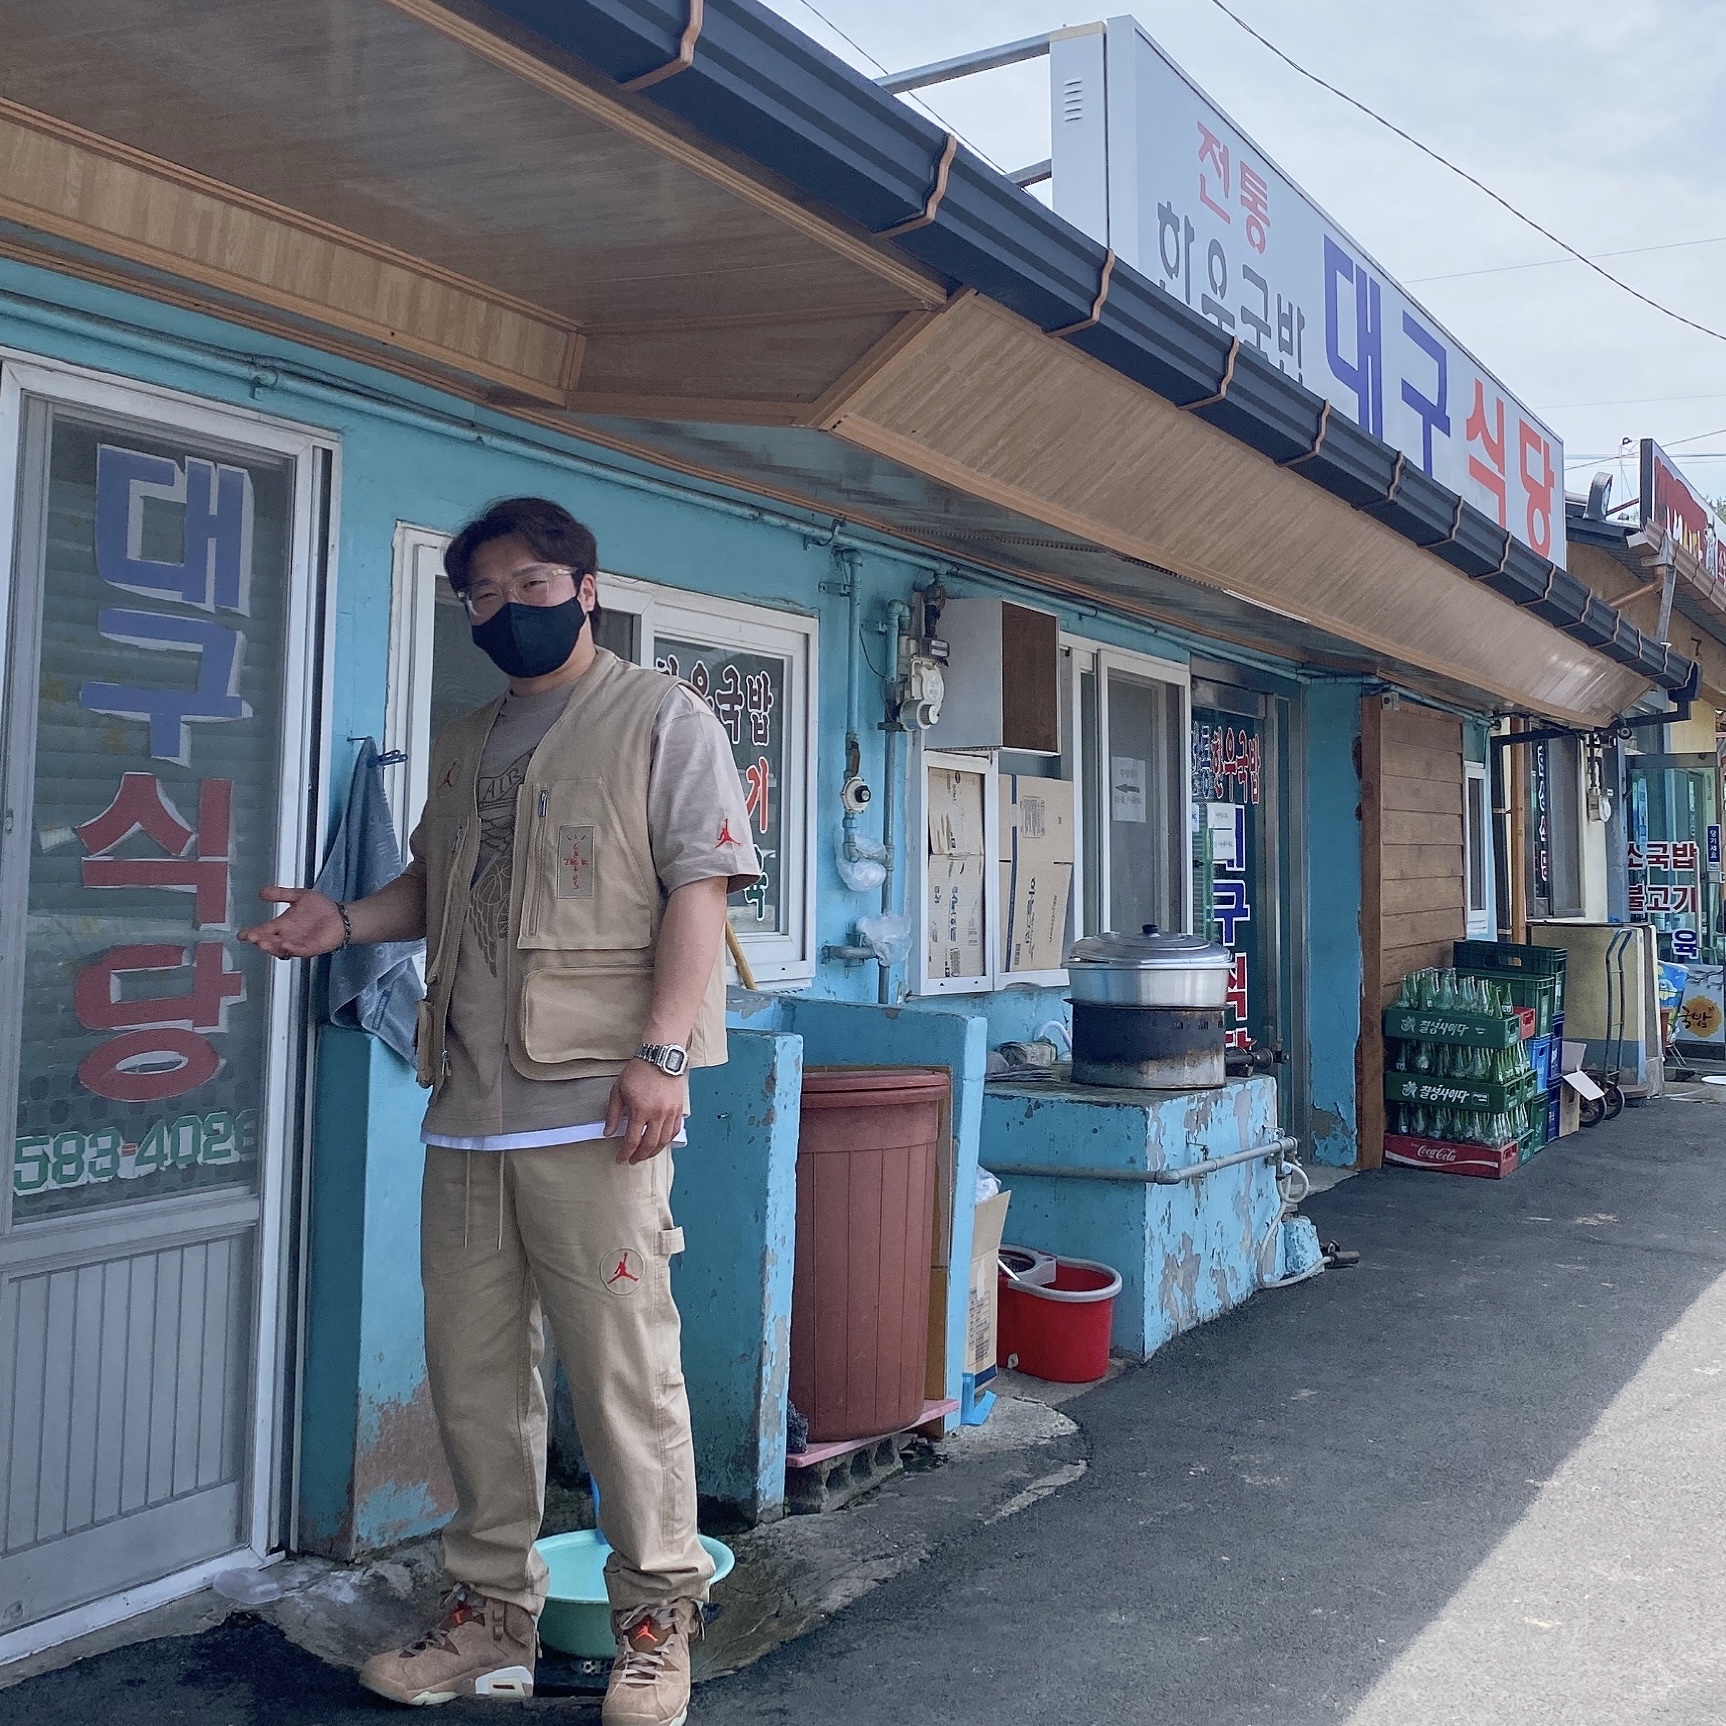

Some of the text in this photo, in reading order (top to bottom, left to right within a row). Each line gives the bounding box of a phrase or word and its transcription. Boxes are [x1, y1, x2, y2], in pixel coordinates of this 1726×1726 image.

[1197, 120, 1271, 254] 전통
[1323, 233, 1556, 559] 대구식당
[75, 442, 255, 1102] 대구식당
[1419, 1018, 1470, 1037] 칠성사이다
[1678, 1005, 1713, 1029] 국밥
[1419, 1084, 1471, 1104] 칠성사이다
